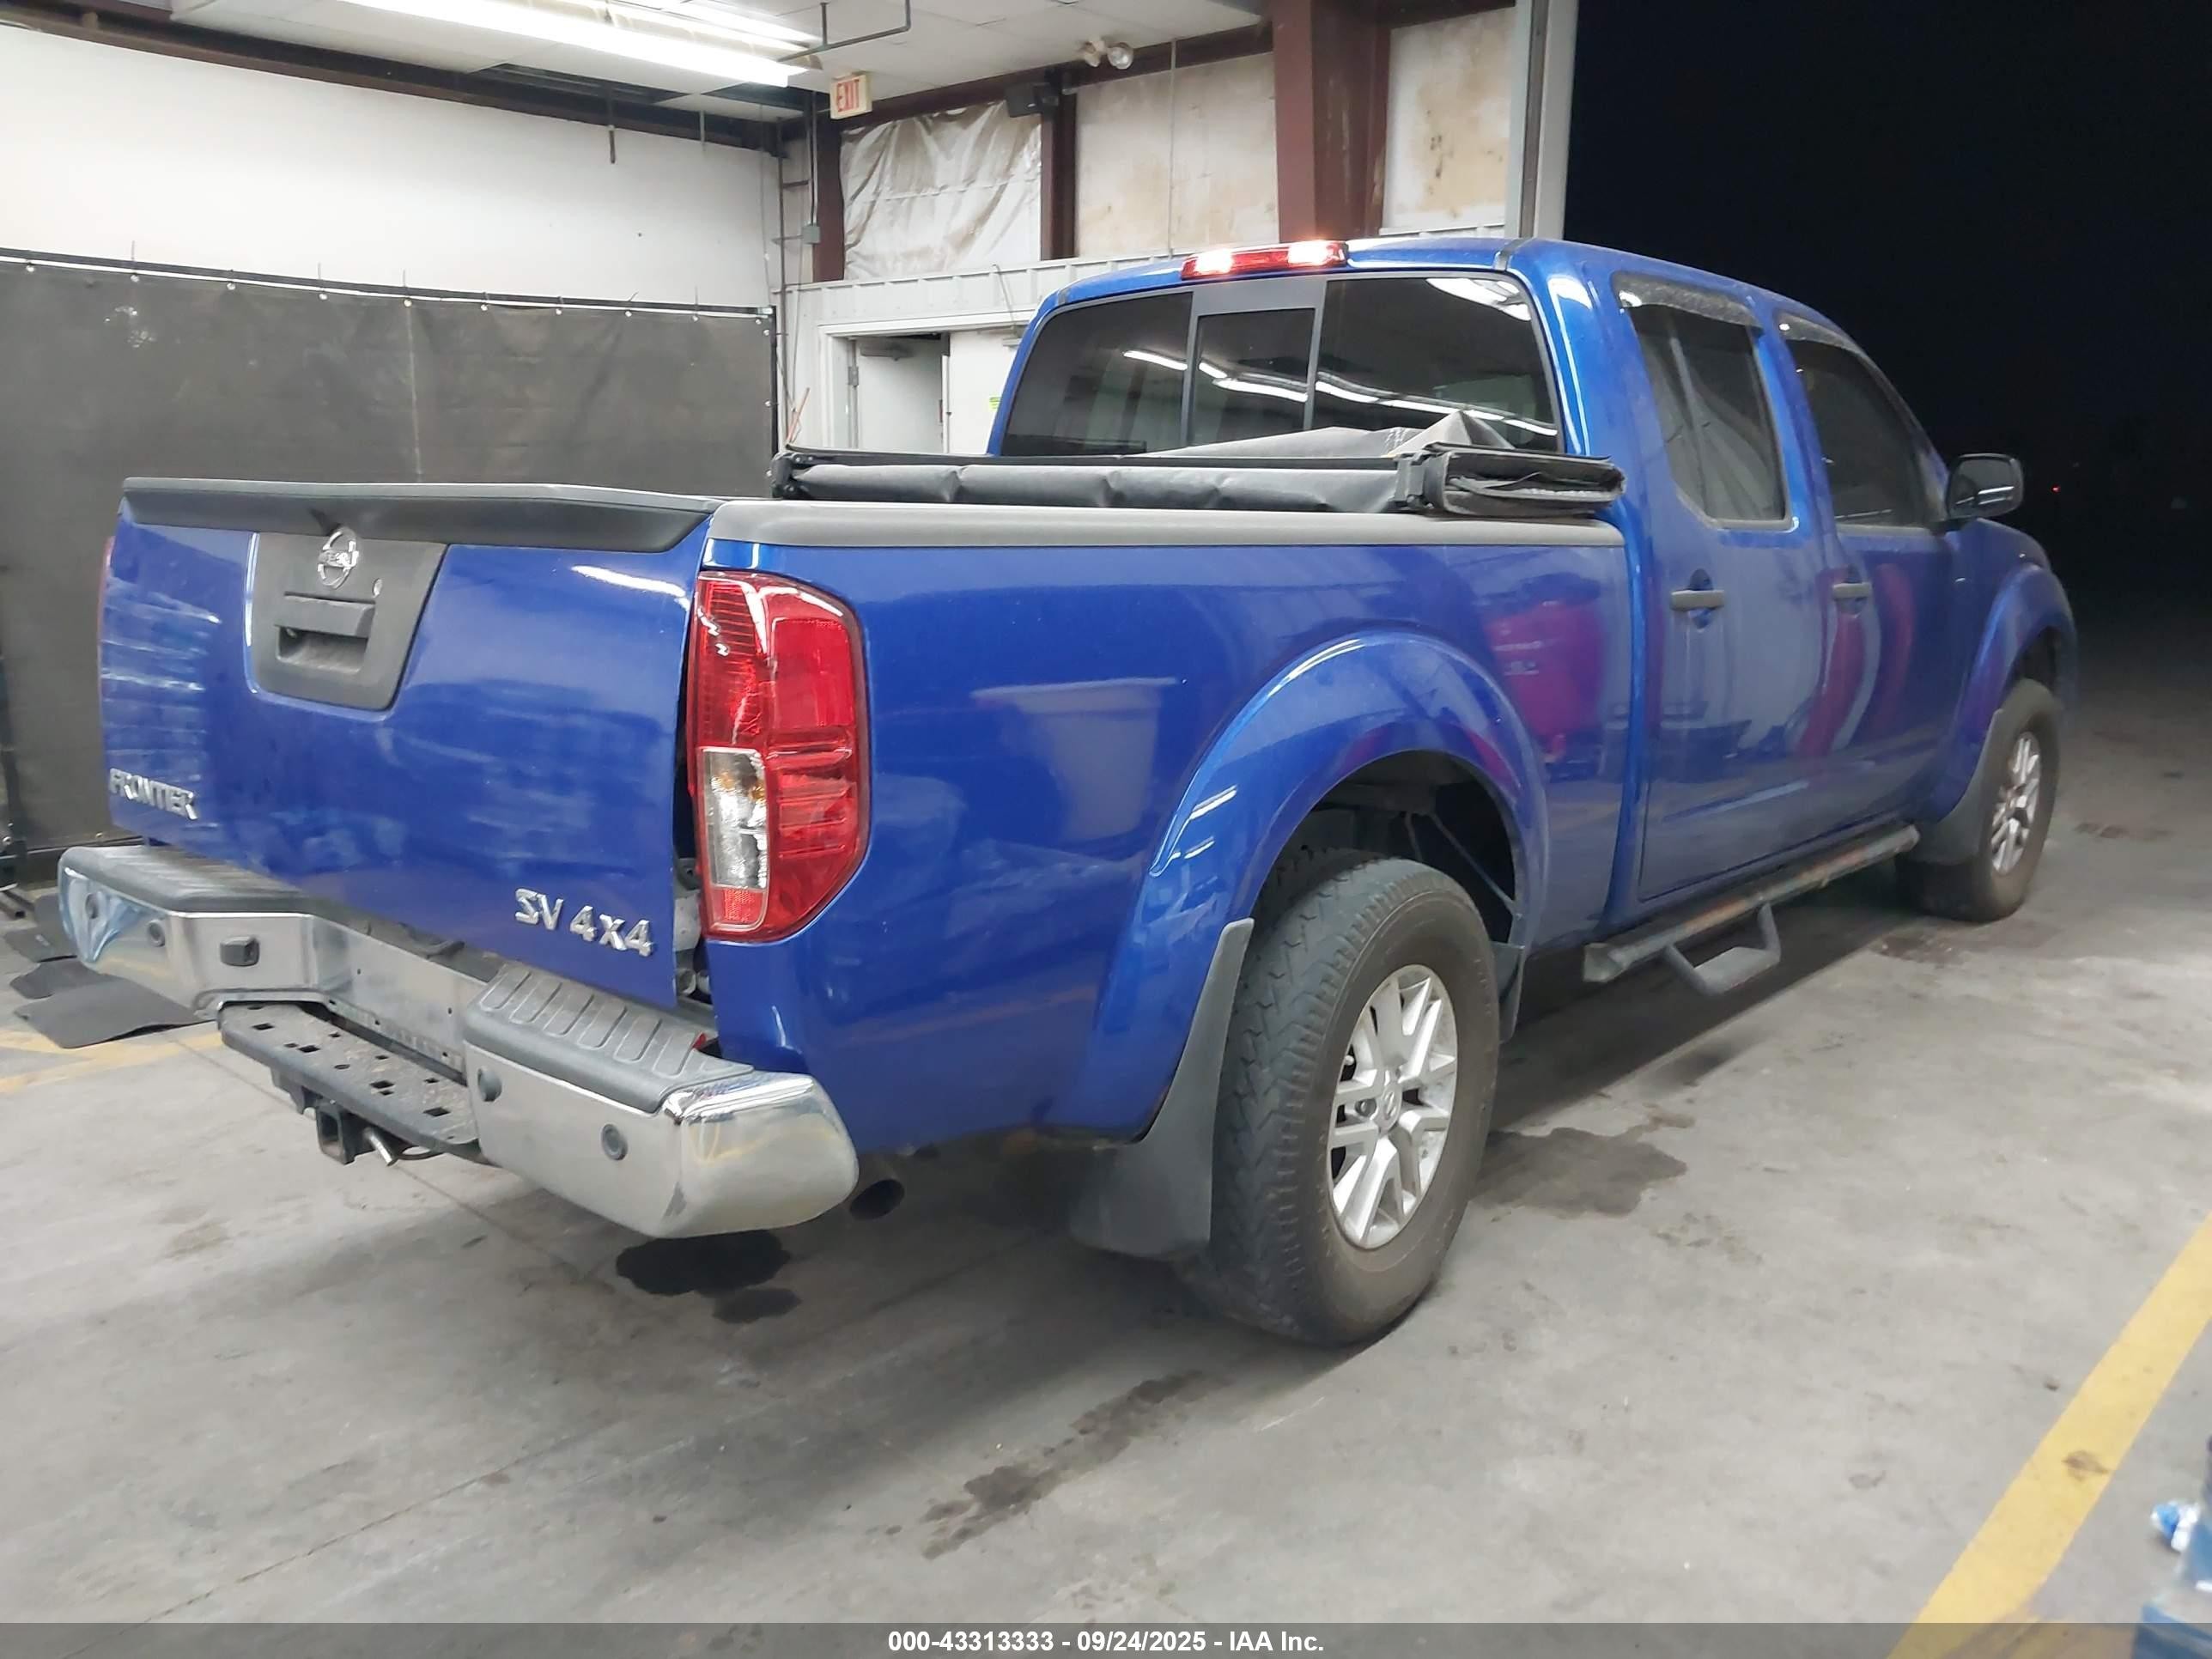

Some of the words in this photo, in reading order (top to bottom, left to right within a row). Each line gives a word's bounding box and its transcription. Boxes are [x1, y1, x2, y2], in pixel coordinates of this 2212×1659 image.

[836, 78, 860, 112] EXIT
[109, 768, 198, 820] FRONTIER
[515, 888, 564, 931] SV
